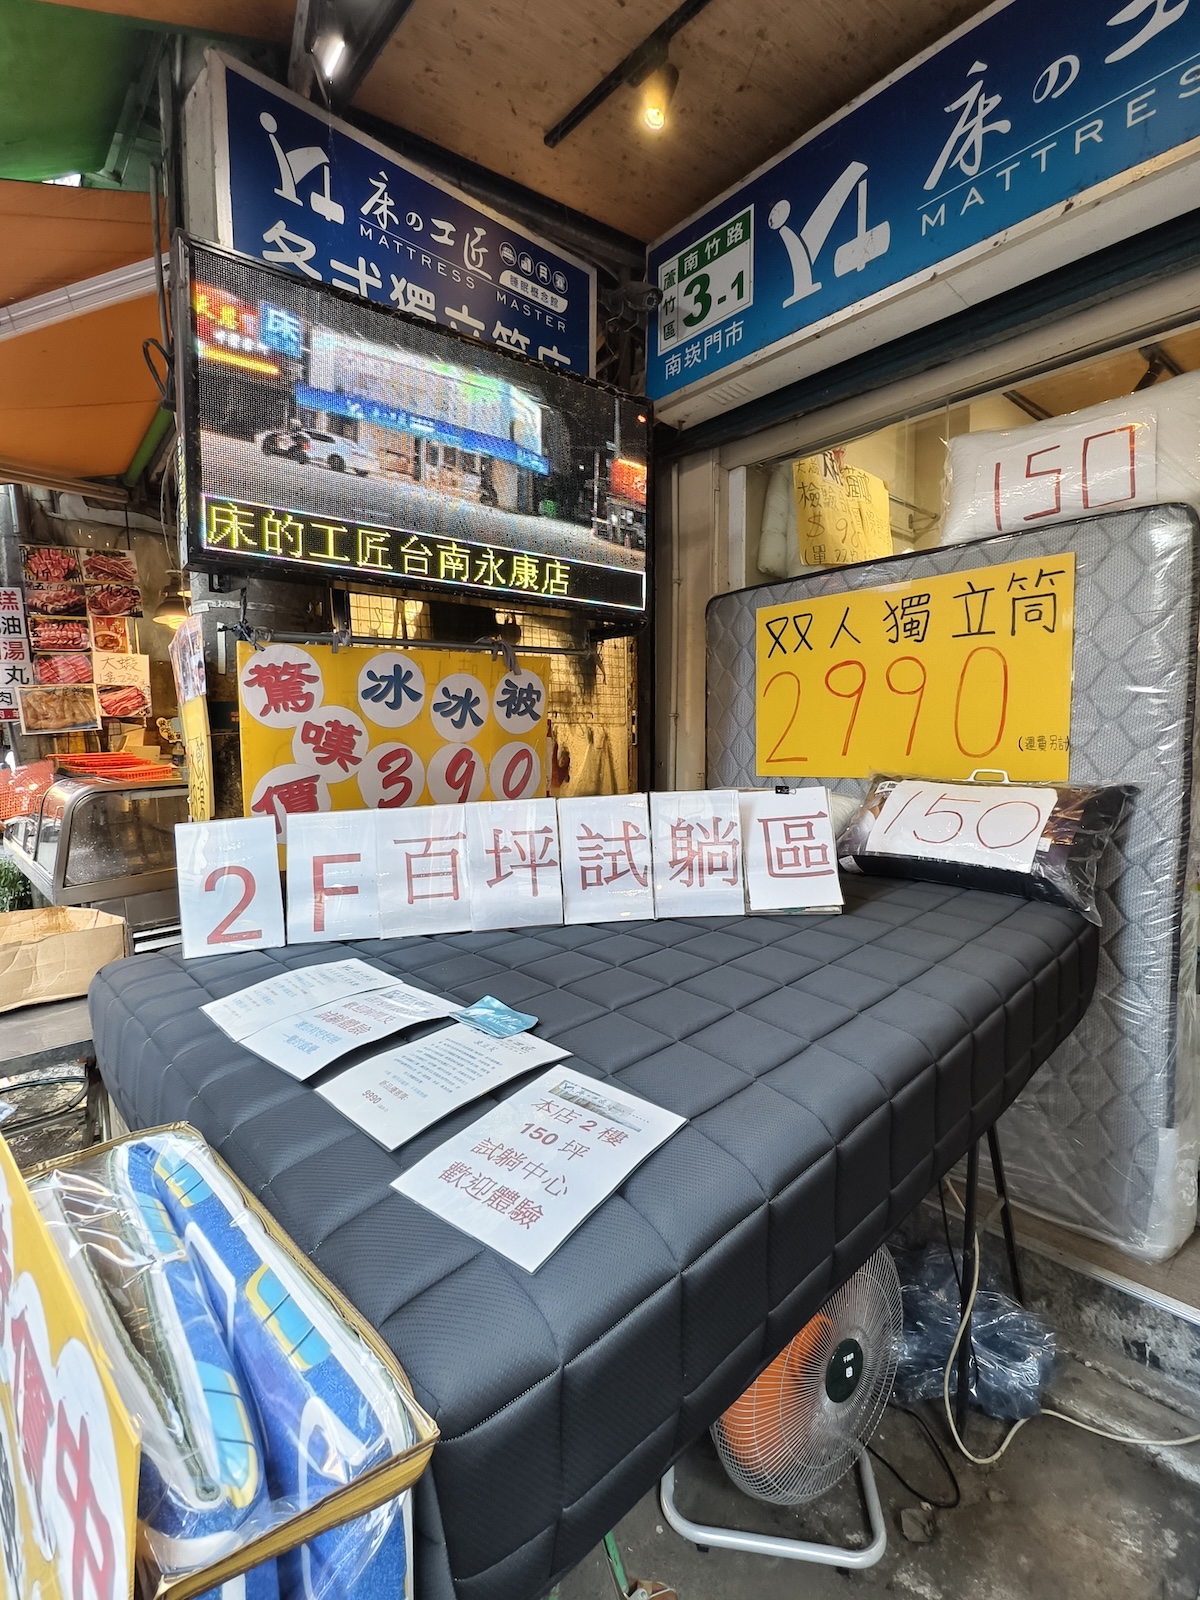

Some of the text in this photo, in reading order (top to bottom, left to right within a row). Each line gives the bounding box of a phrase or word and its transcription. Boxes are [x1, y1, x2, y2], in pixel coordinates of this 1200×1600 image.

[360, 171, 493, 281] 床の工匠
[683, 221, 745, 275] 南竹路
[359, 223, 567, 333] MATTRESS MASTER
[663, 269, 676, 341] 蘆竹區
[682, 270, 745, 328] 3-1
[665, 319, 745, 381] 南崁門市
[992, 424, 1137, 533] 150
[206, 502, 571, 596] 床的工匠台南永康店
[765, 567, 1067, 660] 双人獨立筒
[361, 663, 542, 730] 冰冰被
[762, 646, 1009, 764] 2990
[377, 747, 534, 809] 390
[883, 790, 1041, 850] 150
[519, 1121, 591, 1161] 150 坪
[530, 1097, 582, 1125] 本店
[579, 1119, 598, 1132] 2
[438, 1160, 545, 1231] 歡迎體驗
[470, 1137, 569, 1198] 試躺中心
